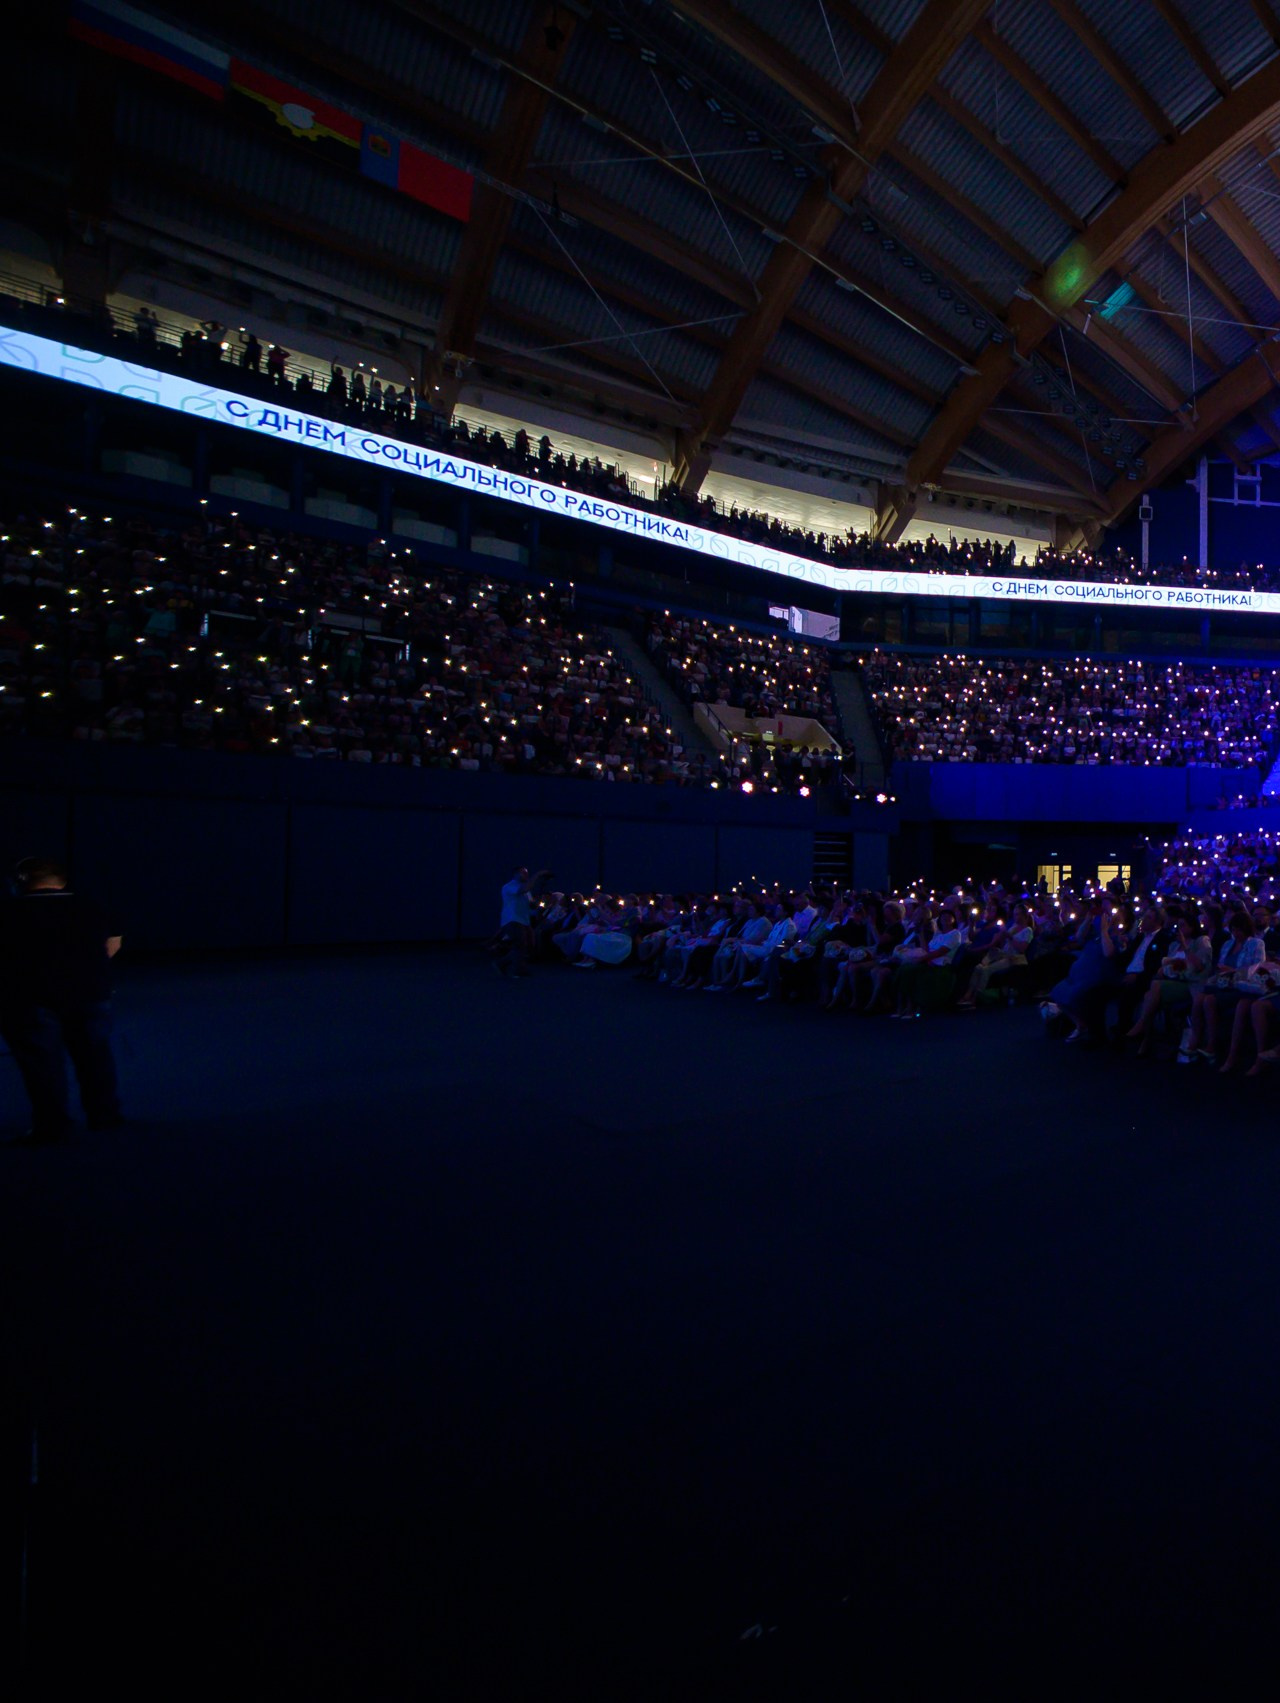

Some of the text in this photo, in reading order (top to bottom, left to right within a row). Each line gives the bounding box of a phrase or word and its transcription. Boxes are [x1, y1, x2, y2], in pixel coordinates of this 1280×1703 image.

[226, 400, 250, 418] С
[360, 438, 556, 504] СОЦИАЛЬНОГО
[565, 494, 689, 542] РАБОТНИКА!
[992, 581, 1003, 592] С
[1054, 584, 1163, 602] СОЦИАЛЬНОГО
[1167, 590, 1252, 606] РАБОТНИКА!
